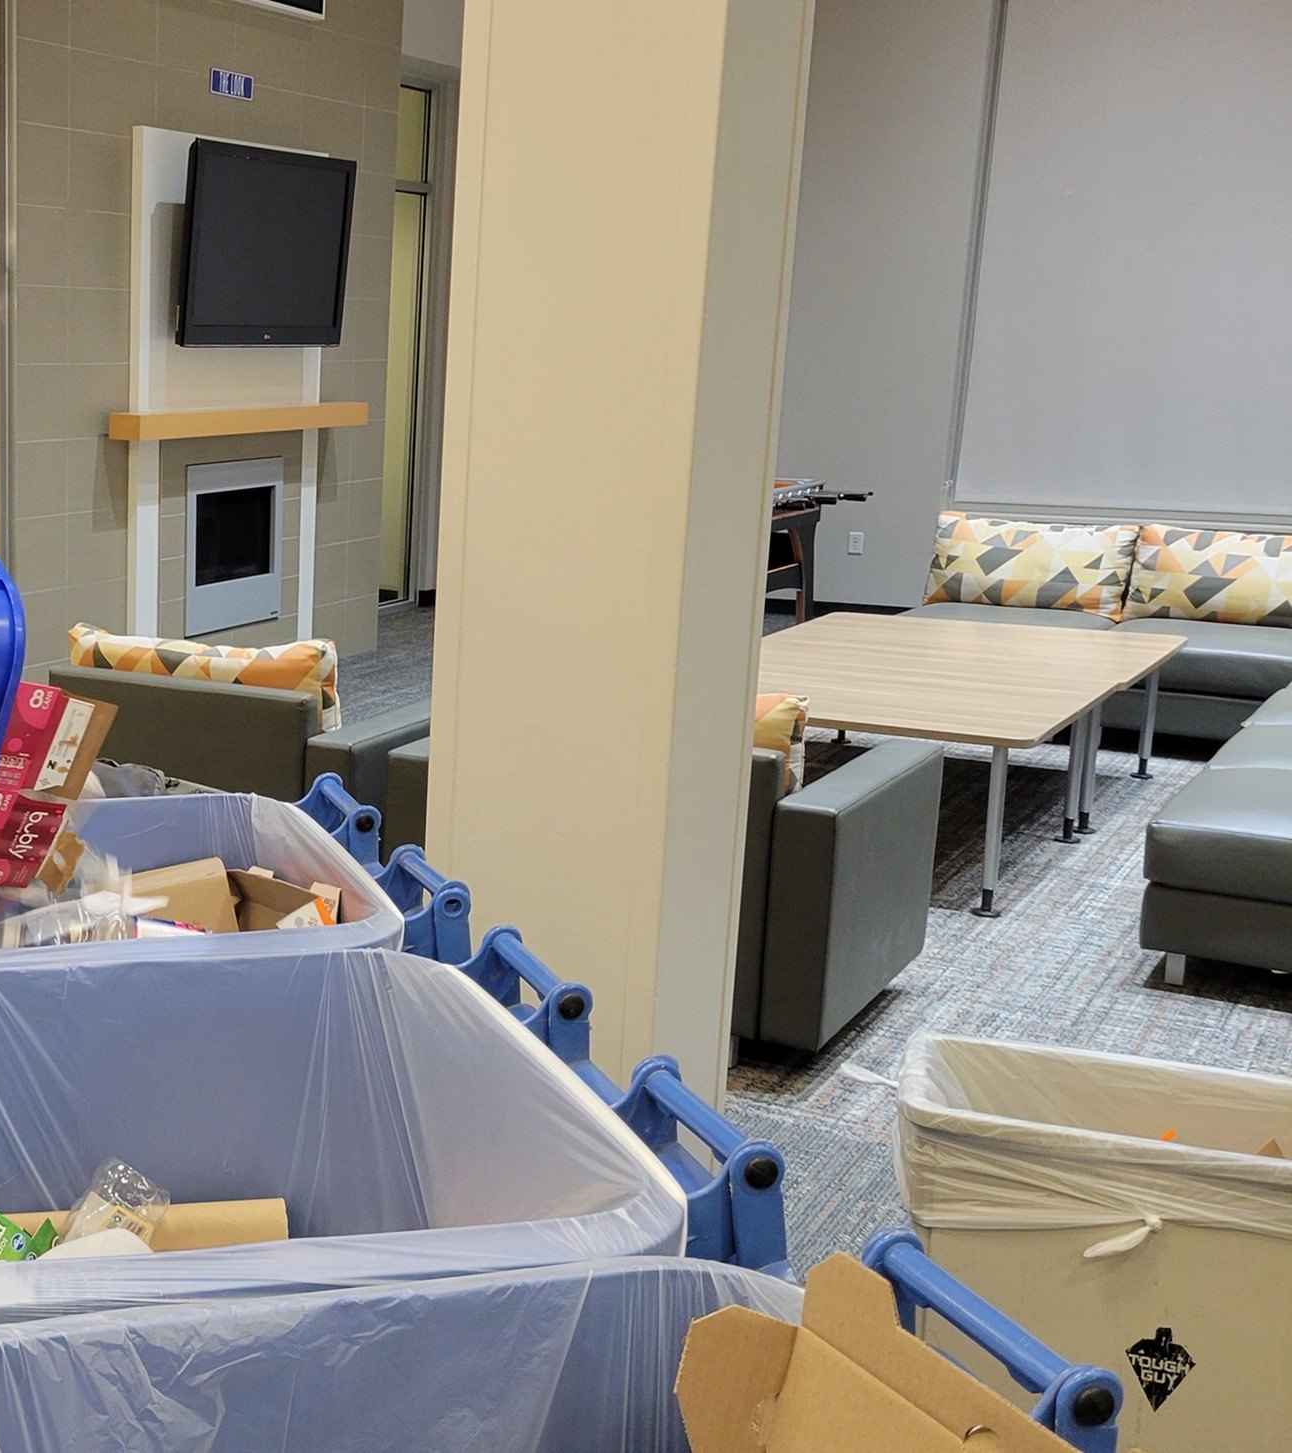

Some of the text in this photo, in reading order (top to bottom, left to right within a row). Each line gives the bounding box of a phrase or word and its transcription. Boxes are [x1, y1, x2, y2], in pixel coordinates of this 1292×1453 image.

[219, 71, 229, 94] THE
[28, 688, 46, 709] 8
[42, 690, 54, 710] CANS
[0, 793, 13, 812] CANS
[8, 811, 49, 860] bubly
[1128, 1353, 1190, 1374] TOUGH
[1140, 1369, 1179, 1391] GUY
